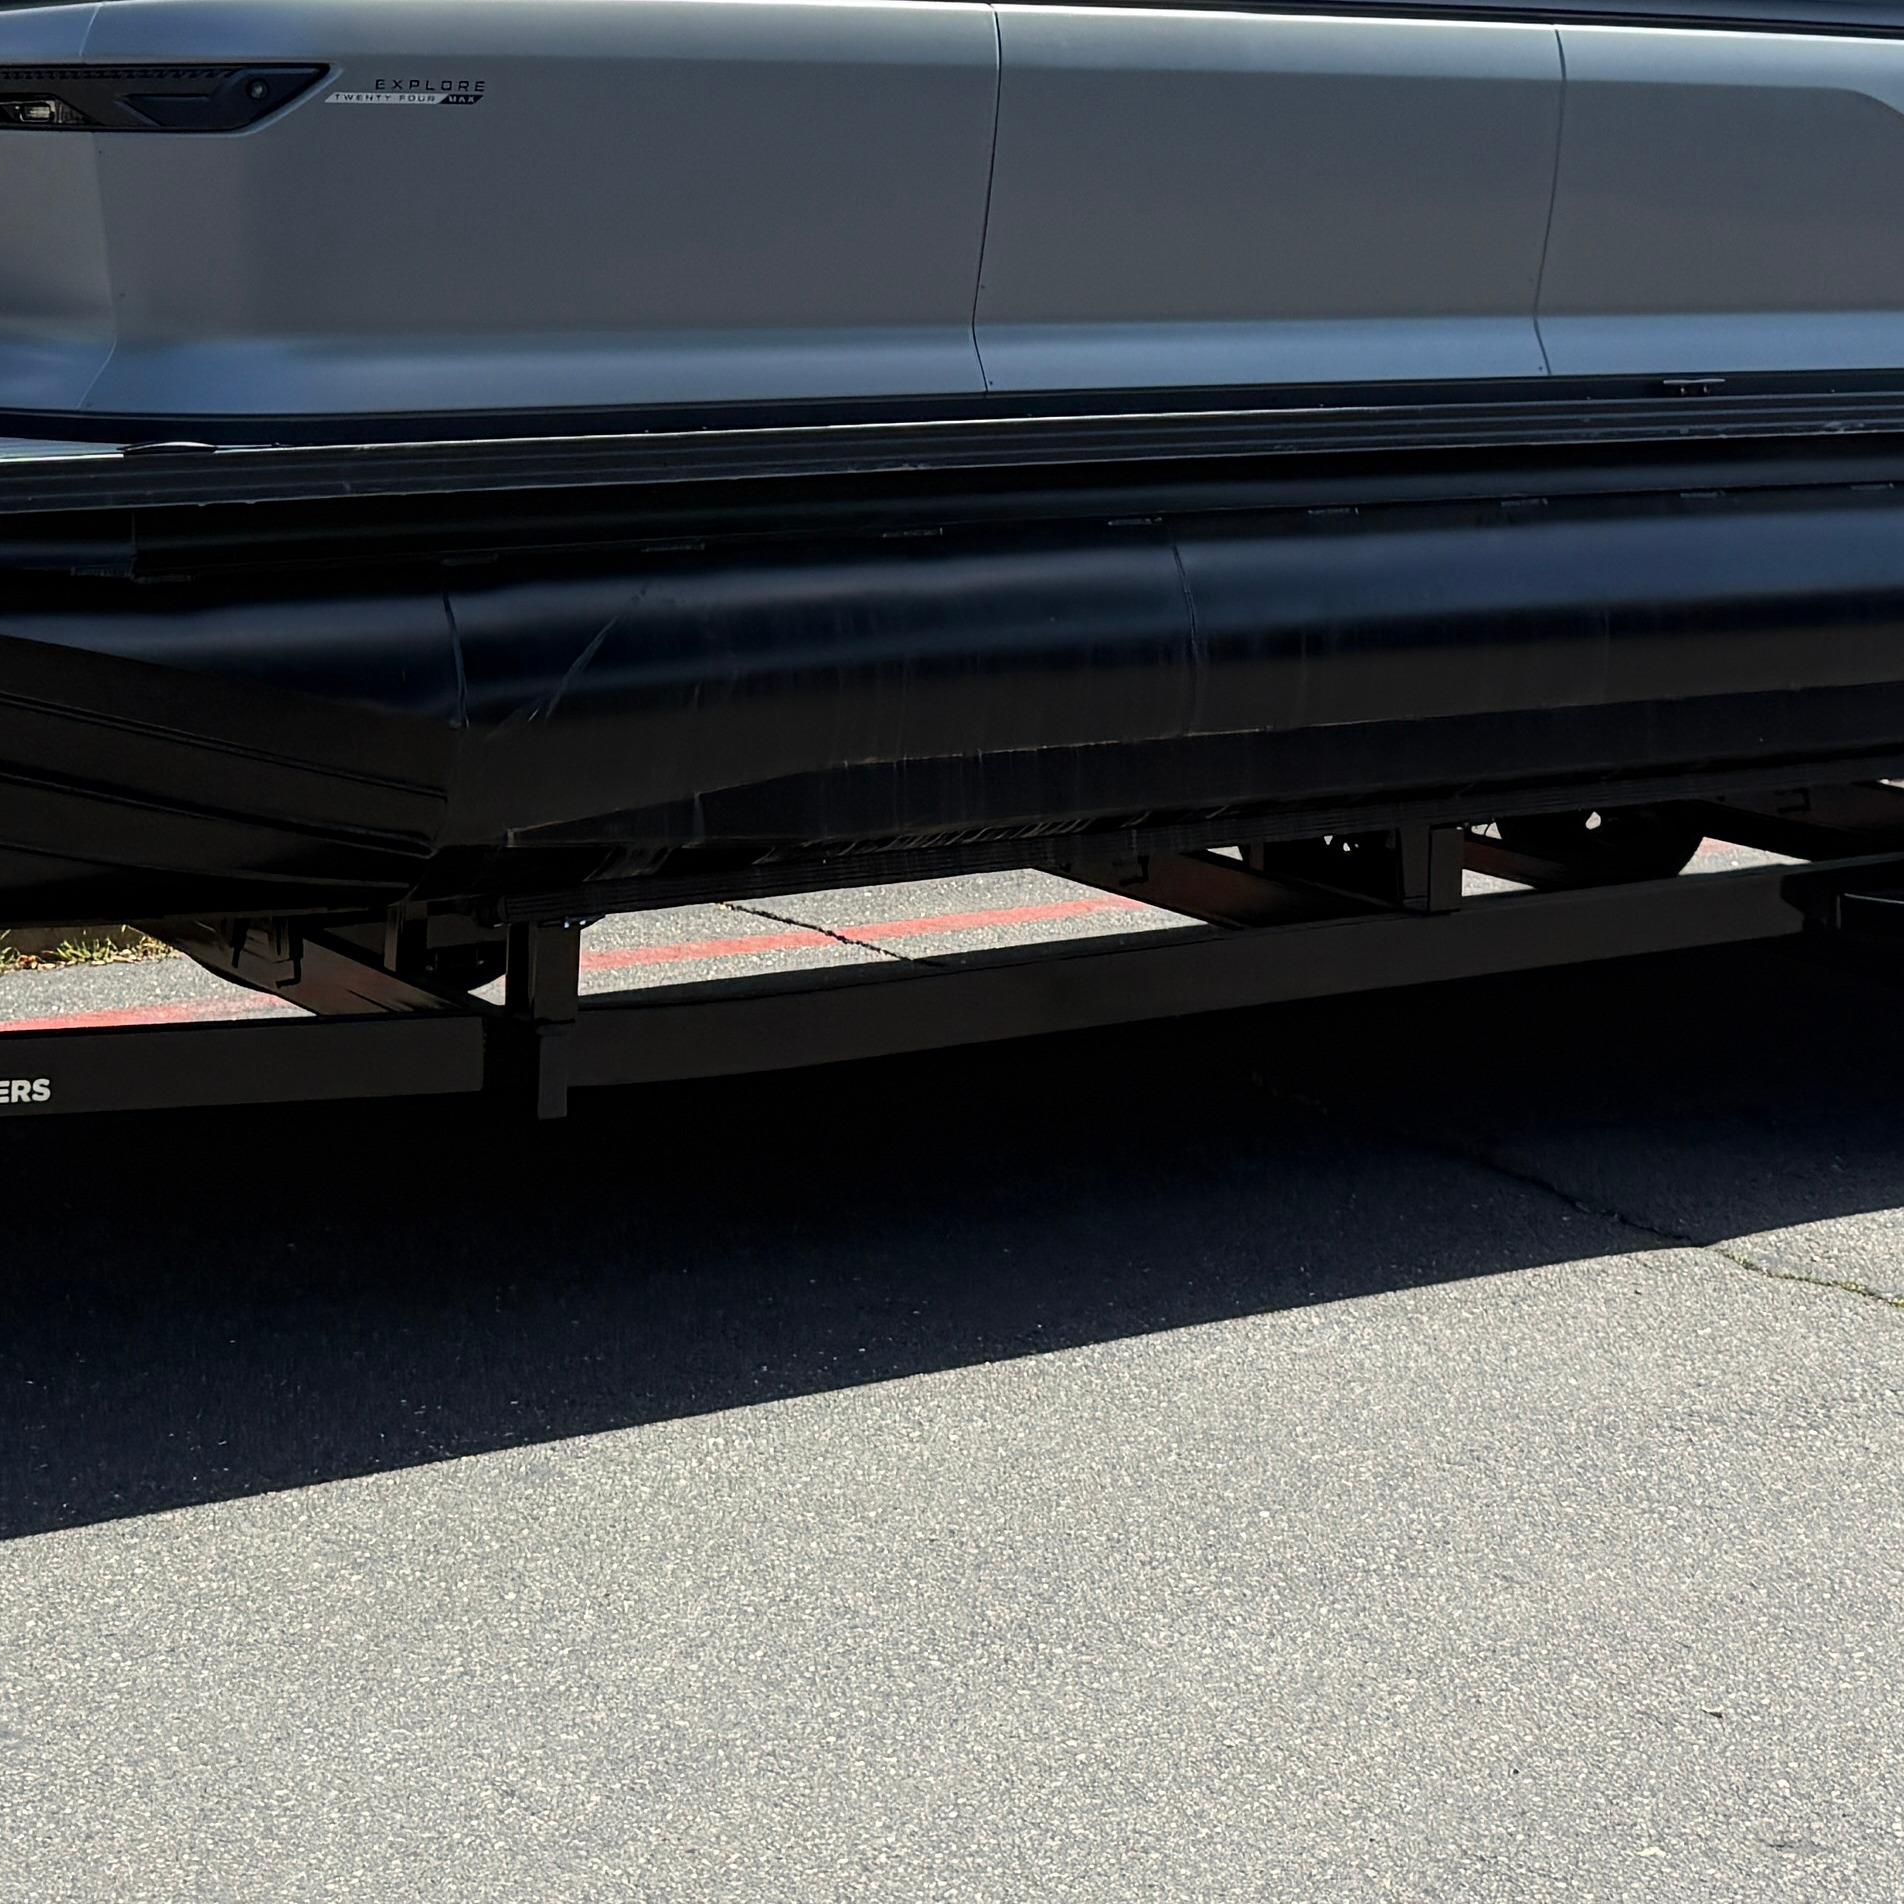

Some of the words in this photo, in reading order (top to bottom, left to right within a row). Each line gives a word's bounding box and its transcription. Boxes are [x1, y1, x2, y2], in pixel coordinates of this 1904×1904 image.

[375, 78, 486, 92] EXPLORE
[335, 93, 392, 101] TWENTY
[399, 94, 436, 102] FOUR
[448, 95, 476, 103] MAX
